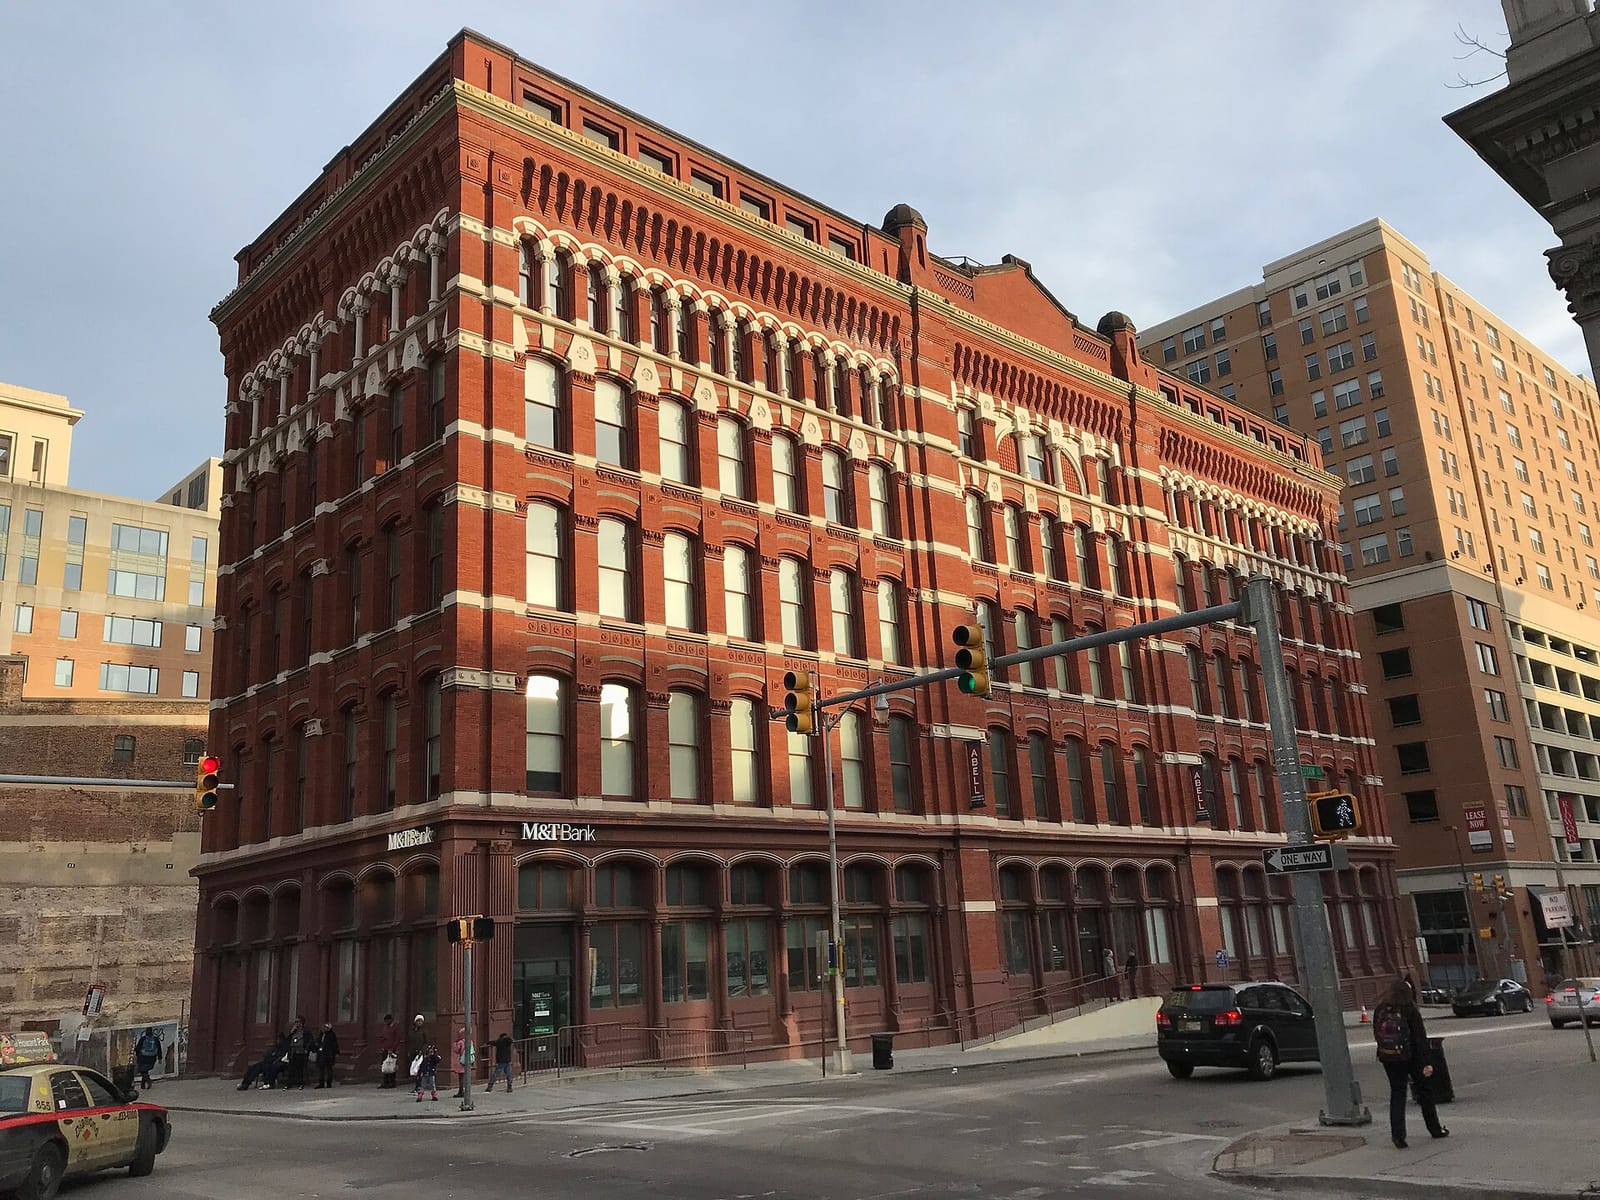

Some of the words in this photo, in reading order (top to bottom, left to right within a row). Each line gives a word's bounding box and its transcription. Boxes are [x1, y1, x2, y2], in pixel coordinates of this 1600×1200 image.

[970, 748, 980, 795] ABELL
[1193, 771, 1205, 810] ABELL
[1465, 810, 1486, 820] LEASE
[1469, 819, 1485, 829] NOW
[1280, 854, 1299, 865] ONE
[1303, 851, 1323, 863] WAY
[1549, 895, 1559, 903] NO
[35, 1099, 51, 1111] 855
